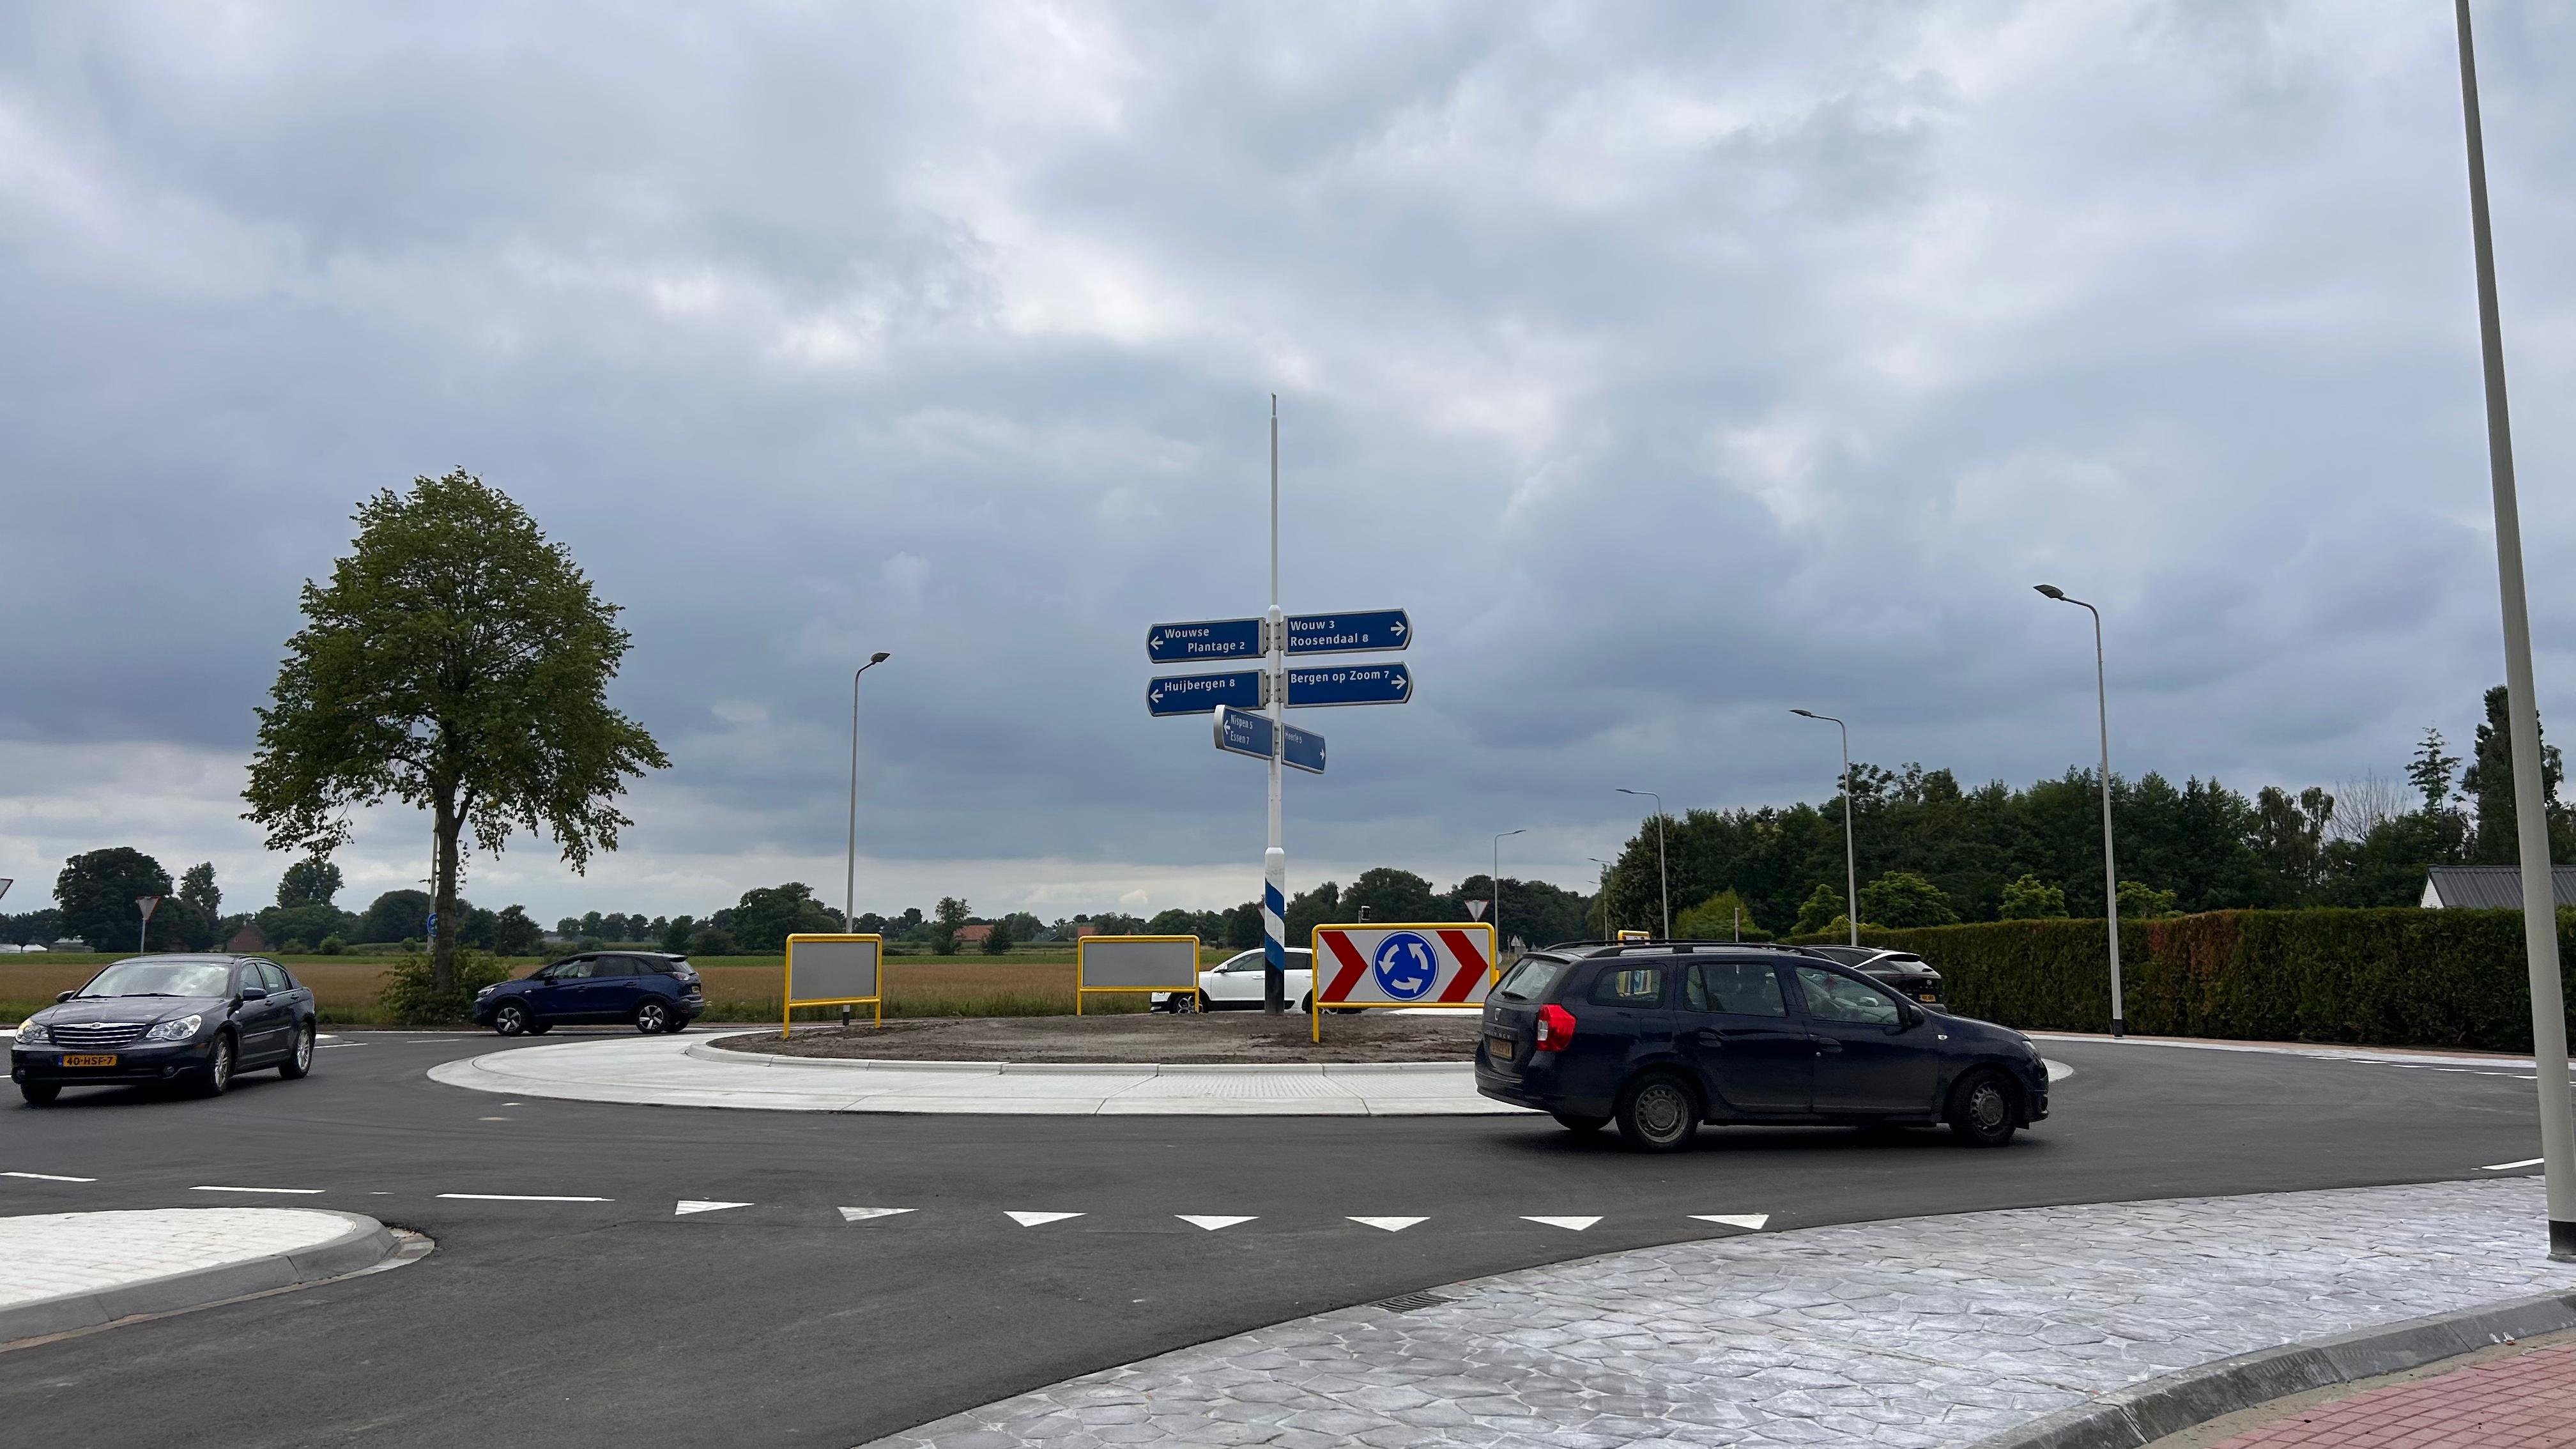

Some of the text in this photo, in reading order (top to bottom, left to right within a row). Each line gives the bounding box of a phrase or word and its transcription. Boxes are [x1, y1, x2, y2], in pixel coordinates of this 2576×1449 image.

[1290, 620, 1335, 631] Wouw 3
[1165, 629, 1209, 639] Wouwse
[1291, 632, 1368, 647] Roosendaal 8
[1188, 641, 1245, 653] Plantage 2
[1291, 670, 1390, 685] Bergen op Zoom 7
[1165, 678, 1235, 693] Huijbergen 8
[1230, 714, 1248, 728] Nispen
[1230, 730, 1246, 743] Essen
